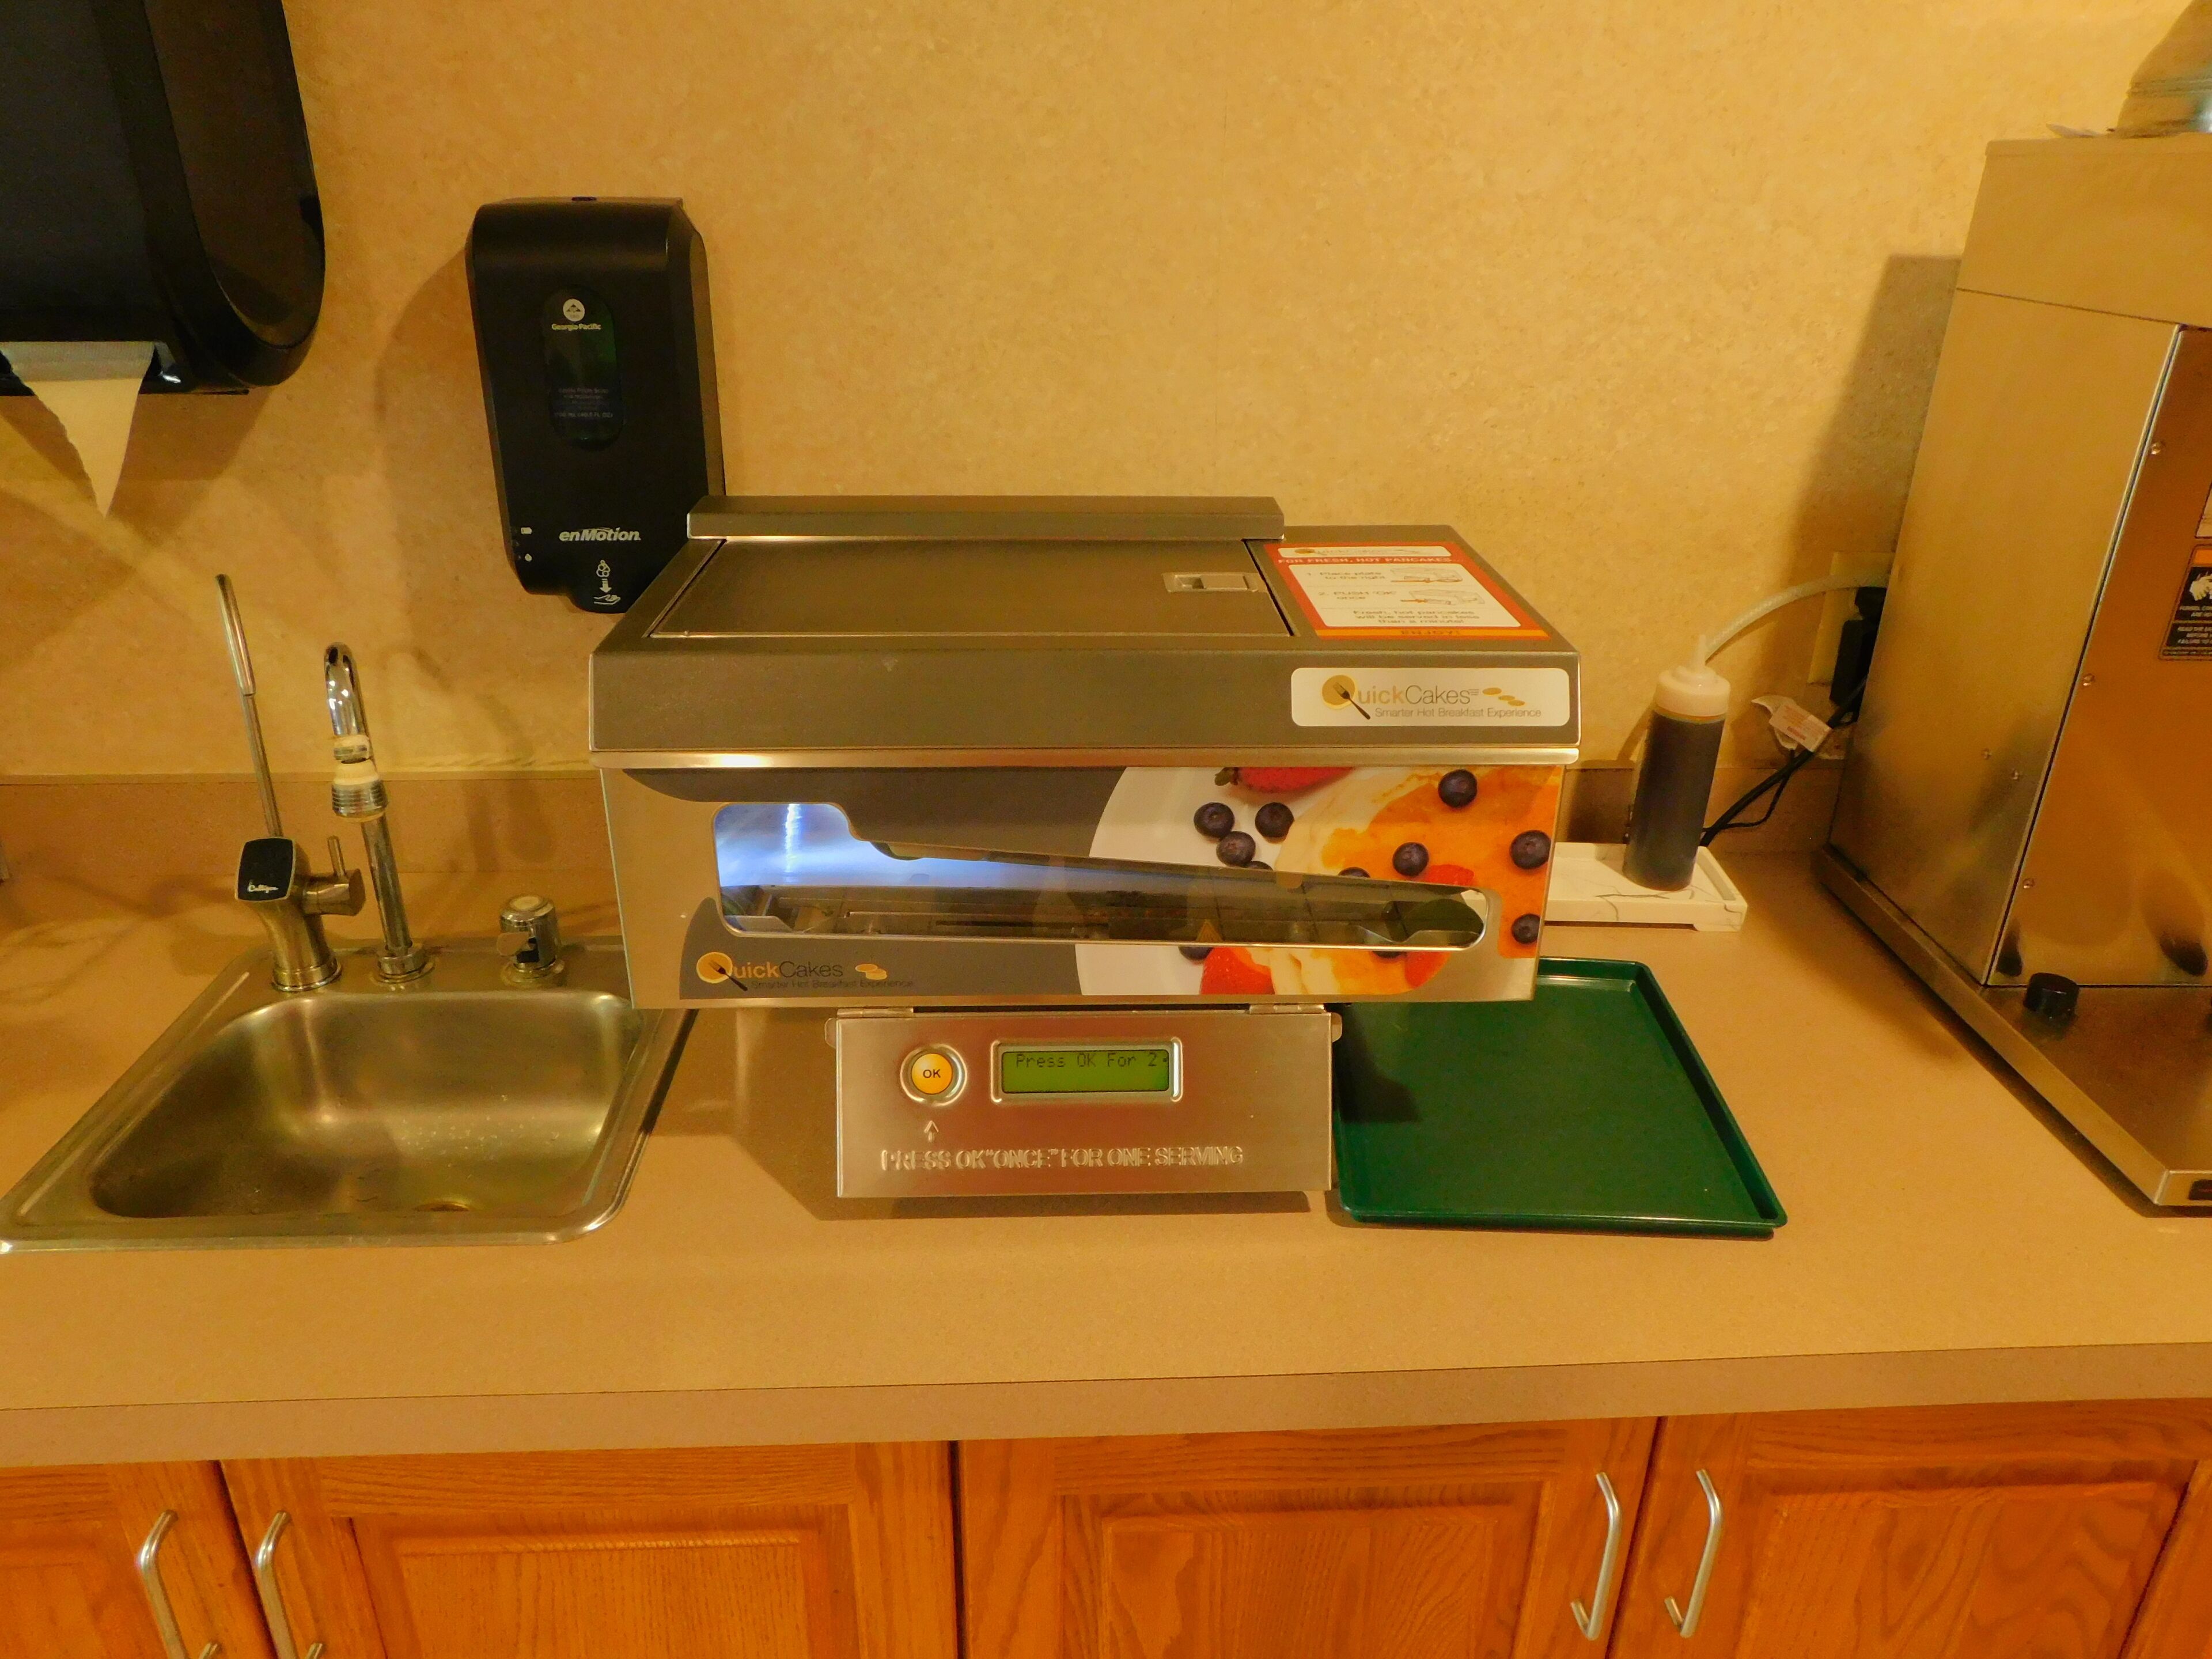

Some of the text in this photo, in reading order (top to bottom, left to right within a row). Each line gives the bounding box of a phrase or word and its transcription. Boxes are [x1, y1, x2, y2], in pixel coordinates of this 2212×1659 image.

[559, 527, 639, 541] enMotion
[1375, 708, 1541, 719] Smarter Hot Breakfast Experience
[859, 979, 913, 988] Experience
[1016, 1053, 1066, 1068] Press
[1077, 1052, 1096, 1067] OK
[1107, 1052, 1136, 1067] For
[922, 1069, 941, 1079] OK
[880, 1149, 950, 1171] PRESS
[955, 1149, 986, 1169] OK
[1060, 1147, 1104, 1168] FOR
[1107, 1146, 1151, 1167] ONE
[1154, 1145, 1244, 1166] SERVING
